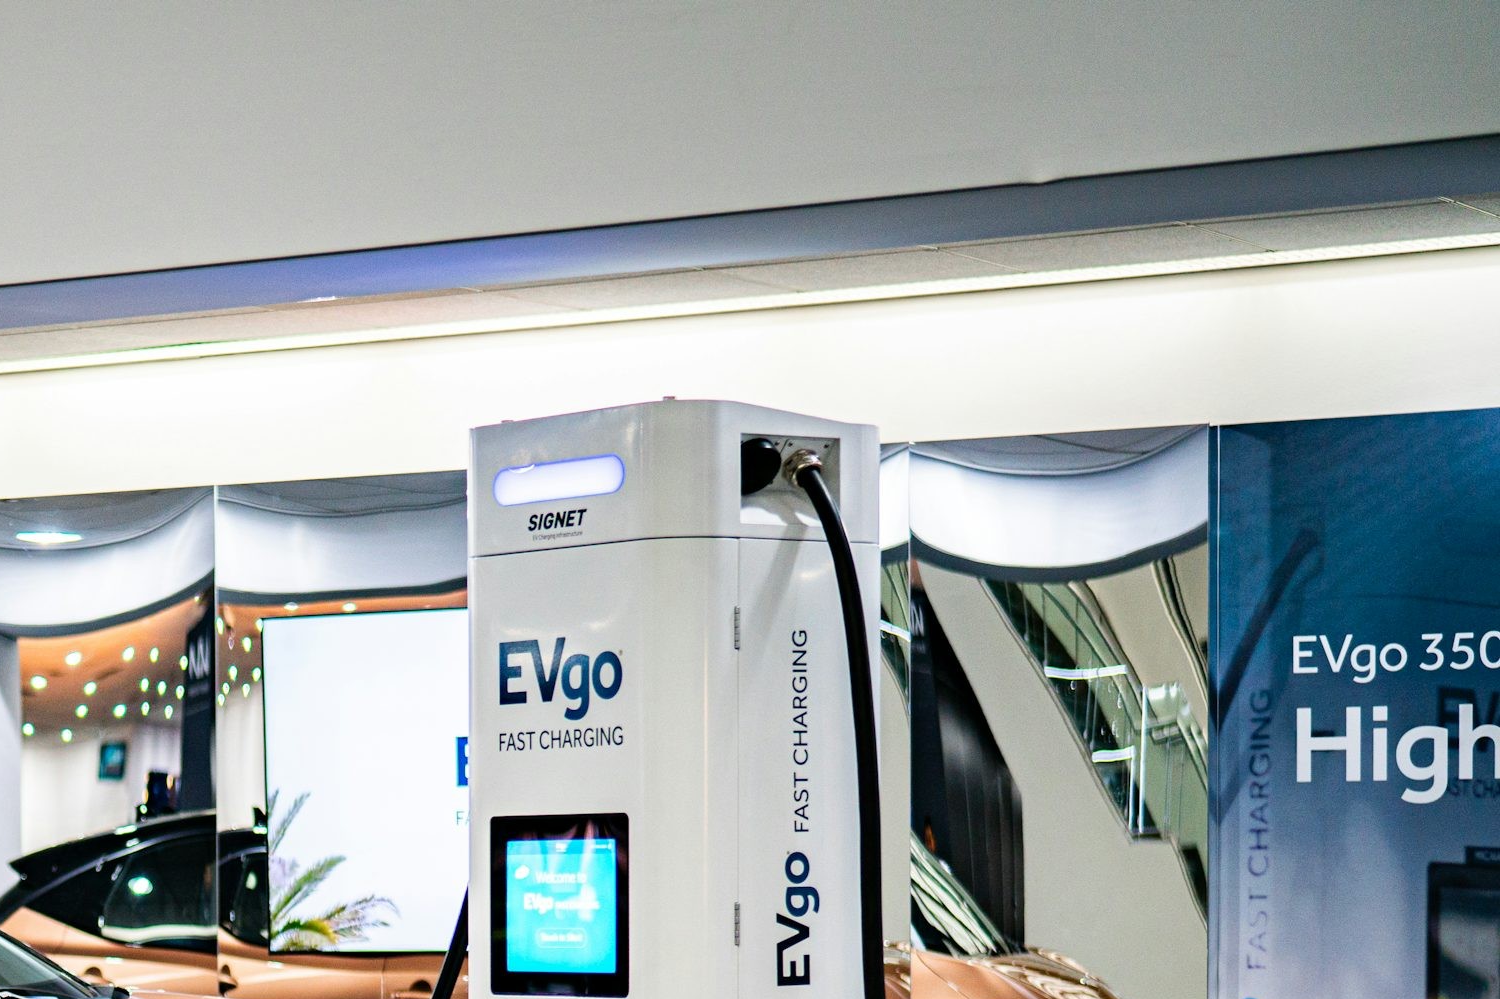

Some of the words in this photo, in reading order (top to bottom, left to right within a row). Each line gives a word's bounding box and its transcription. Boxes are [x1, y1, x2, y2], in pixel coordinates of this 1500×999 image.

[528, 508, 587, 531] SIGNET
[499, 636, 623, 721] EVgo
[791, 629, 808, 766] CHARGING
[1293, 633, 1408, 684] EVgo
[498, 731, 536, 752] FAST
[539, 726, 624, 750] CHARGING
[1296, 703, 1500, 804] High
[793, 771, 809, 833] FAST
[1247, 687, 1273, 878] CHARGING
[776, 850, 821, 987] EVgo
[1246, 892, 1269, 971] FAST
